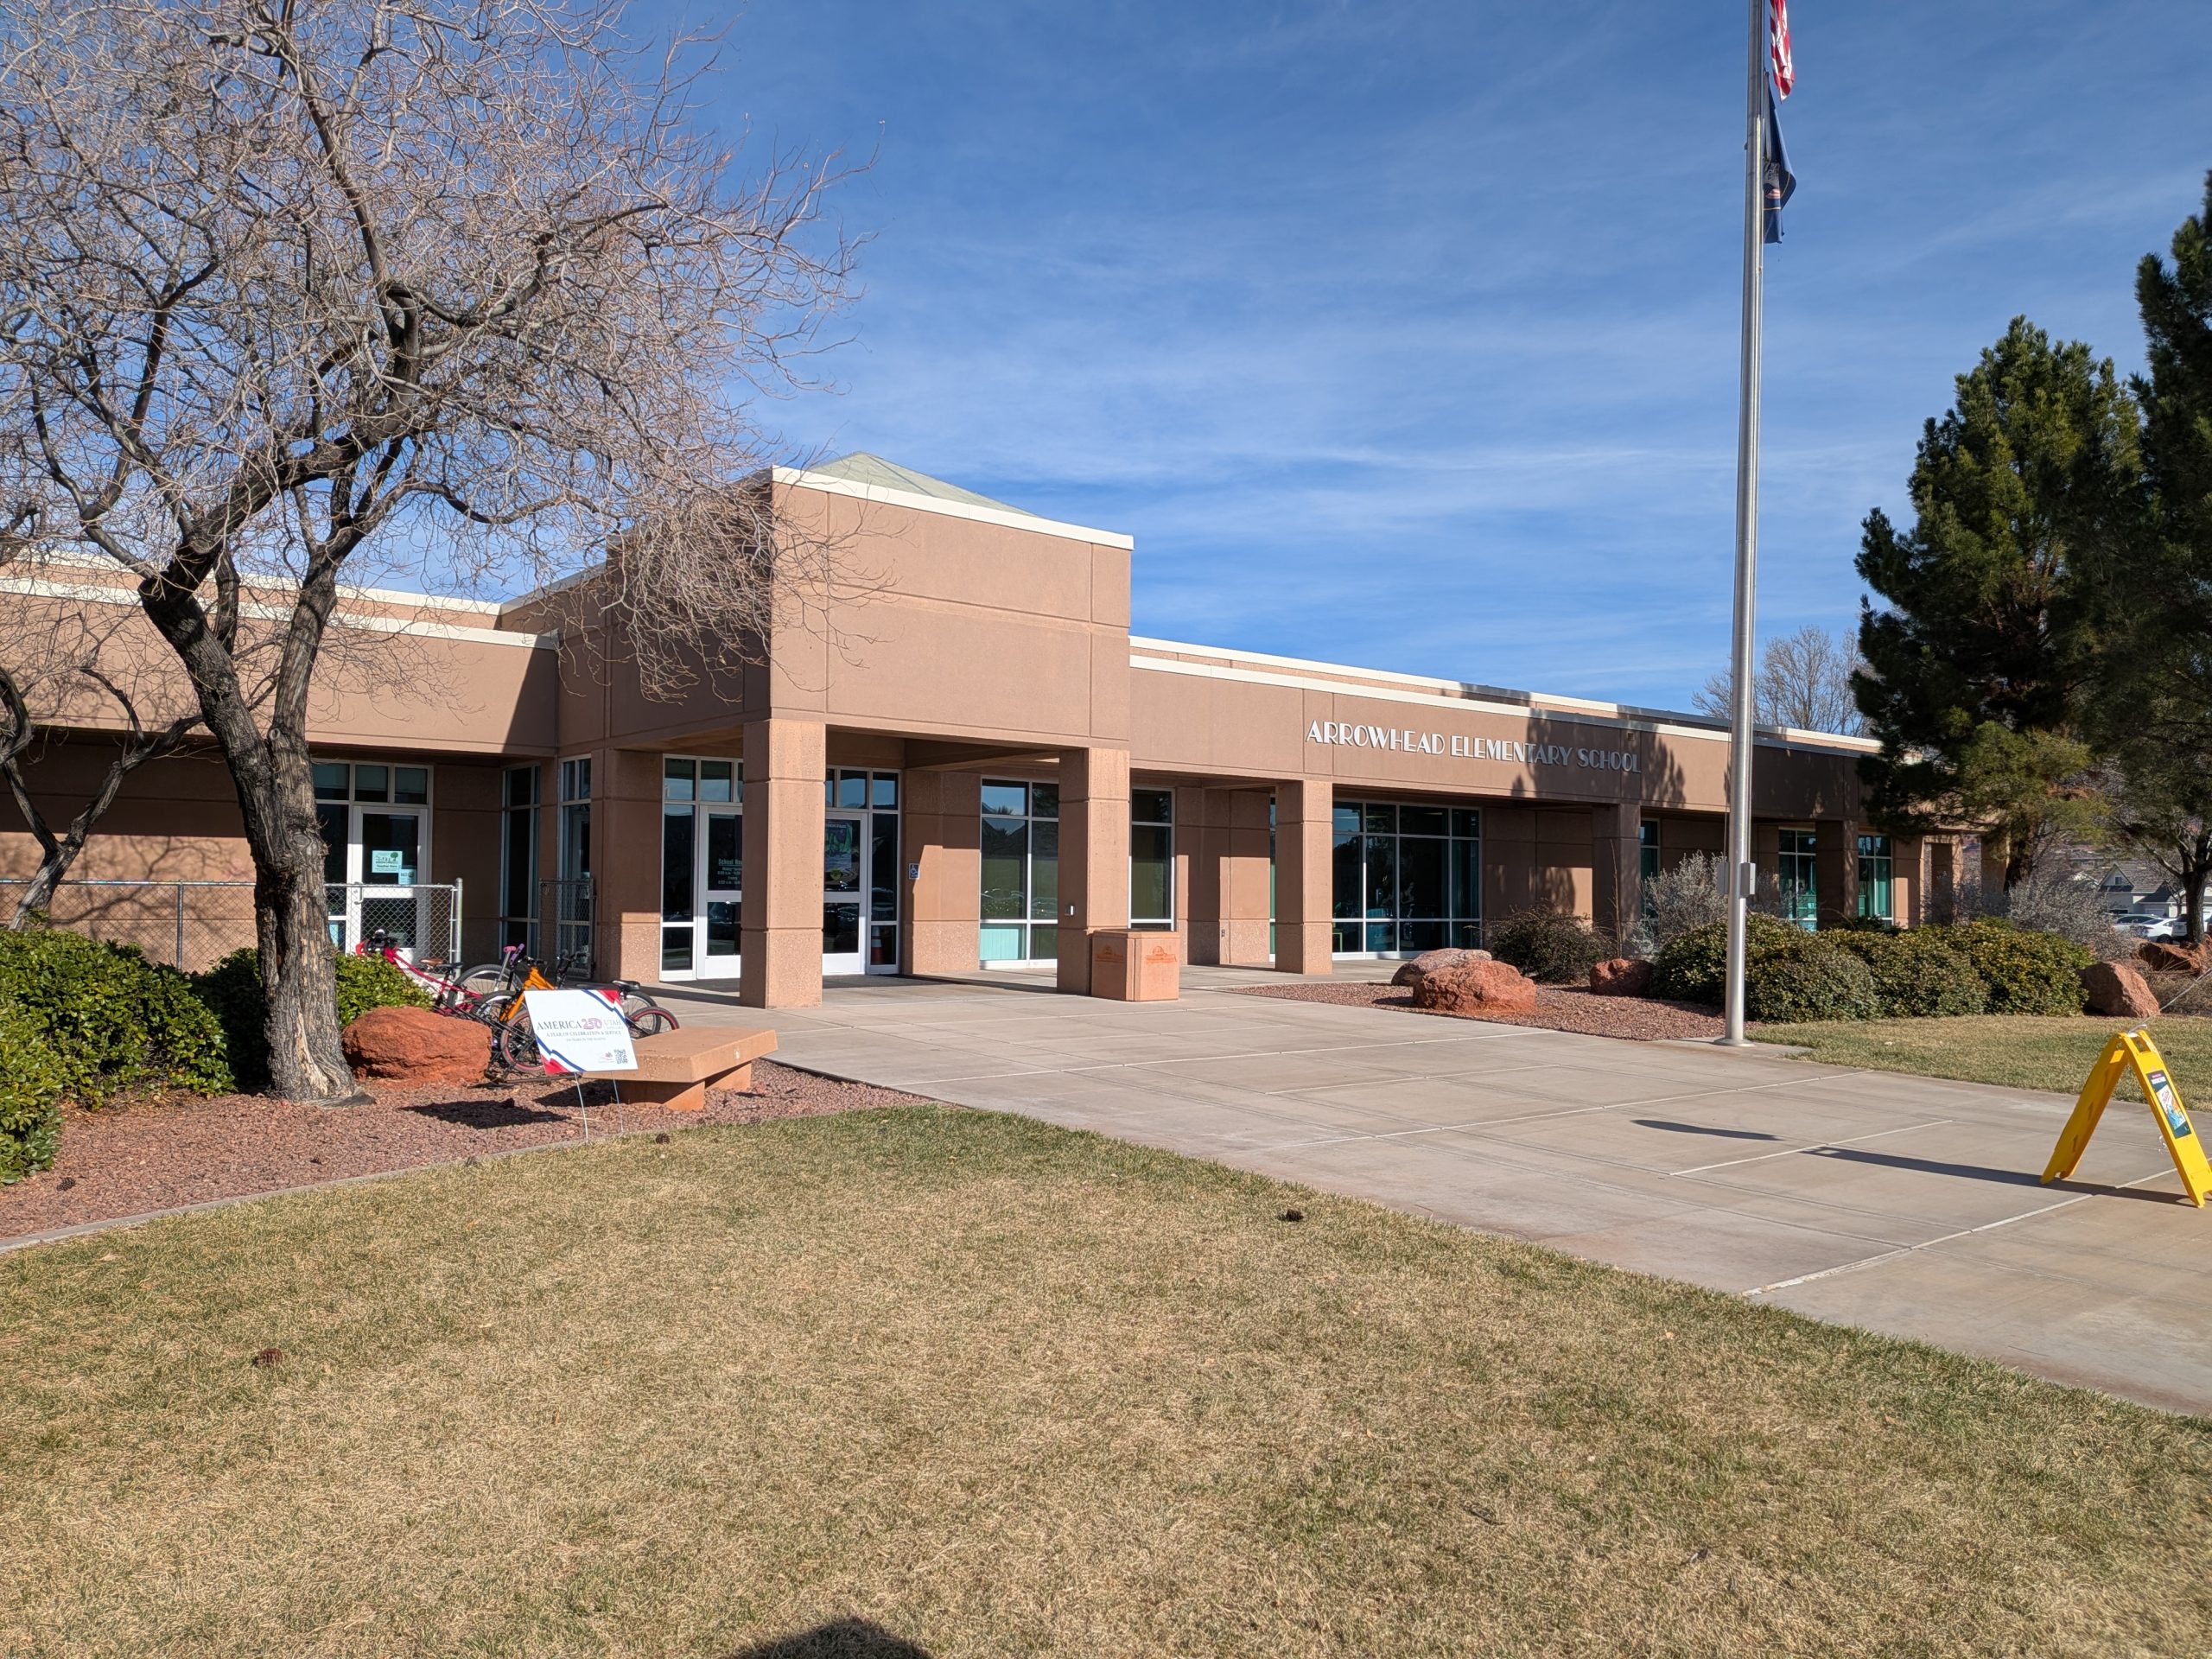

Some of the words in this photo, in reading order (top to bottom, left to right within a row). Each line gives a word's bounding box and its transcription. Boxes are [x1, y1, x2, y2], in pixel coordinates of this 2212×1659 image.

[1306, 720, 1445, 755] ARROWHEAD
[1449, 734, 1573, 766] ELEMENTARY
[1577, 748, 1642, 773] SCHOOL
